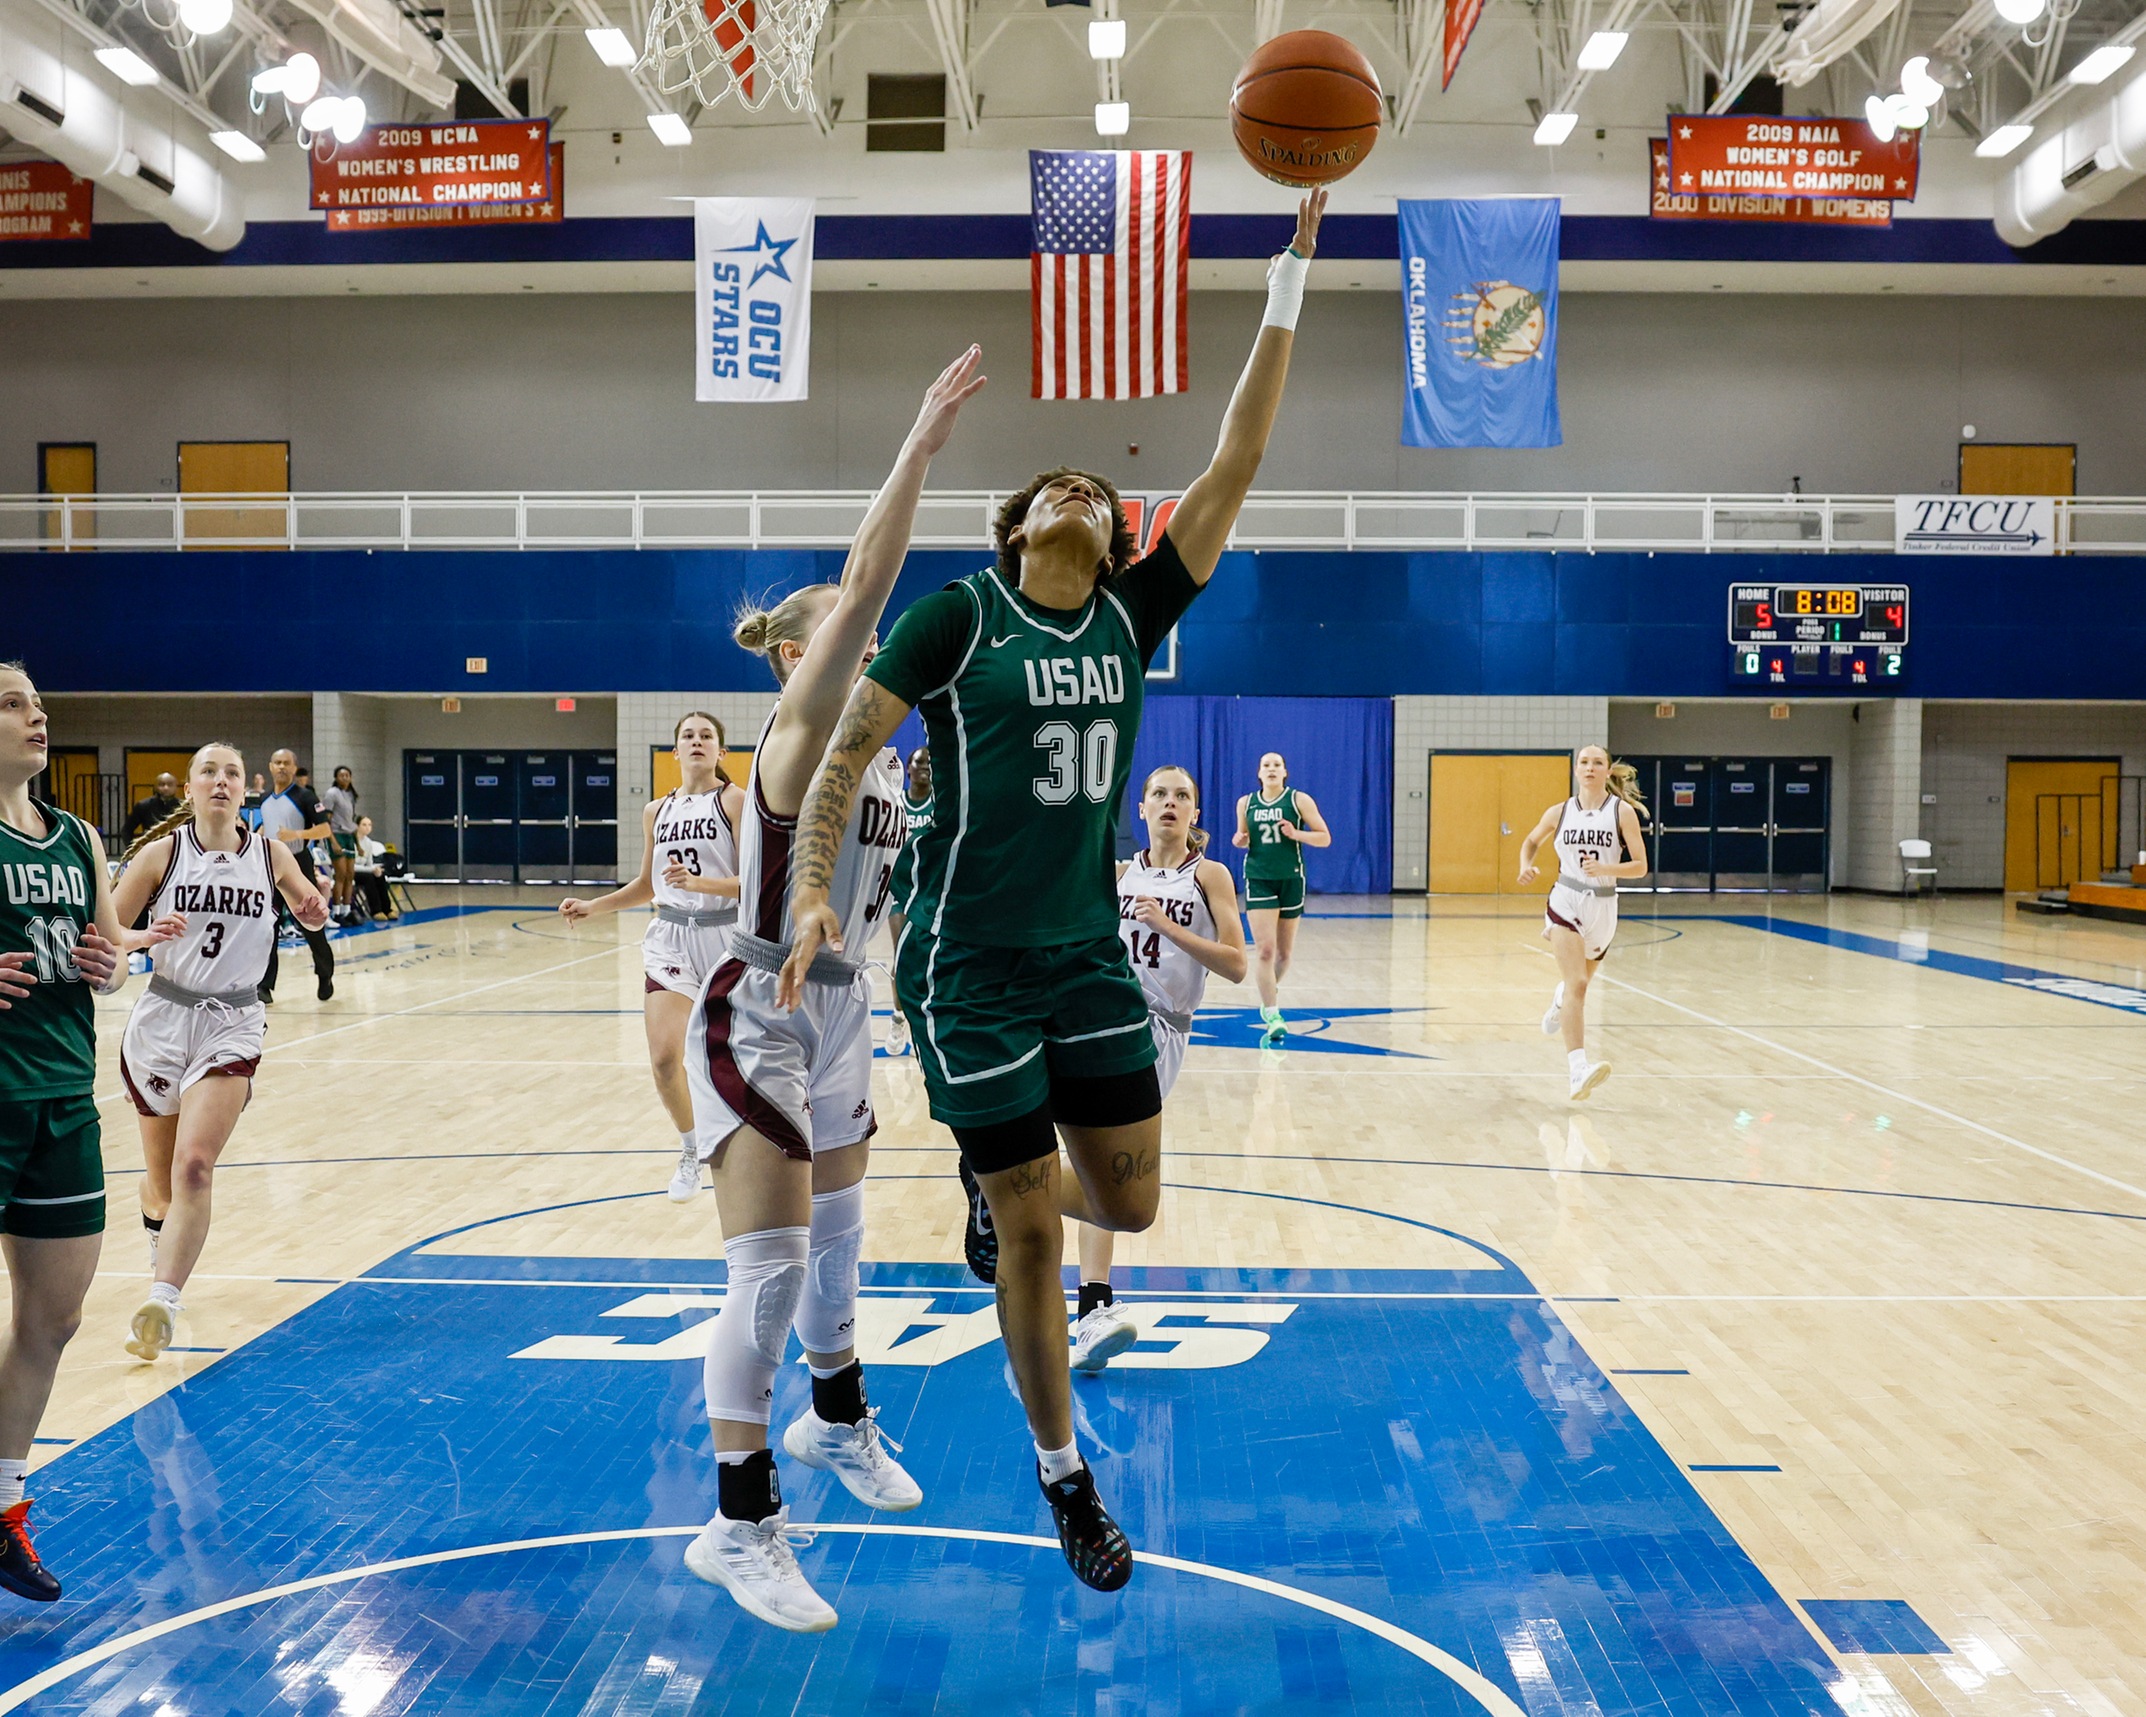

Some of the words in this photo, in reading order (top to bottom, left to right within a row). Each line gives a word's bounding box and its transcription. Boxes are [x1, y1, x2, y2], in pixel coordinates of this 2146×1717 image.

[378, 130, 422, 147] 2009
[430, 127, 479, 145] WCWA
[1747, 124, 1793, 142] 2009
[1798, 126, 1841, 143] NAIA
[1258, 136, 1359, 167] SPALDING
[1726, 147, 1809, 167] WOMEN'S
[1814, 150, 1862, 168] GOLF
[337, 158, 415, 176] WOMEN'S
[420, 153, 520, 174] WRESTLING
[0, 171, 29, 190] NIS
[1701, 170, 1788, 188] NATIONAL
[1793, 172, 1885, 191] CHAMPION
[338, 185, 423, 204] NATIONAL
[432, 181, 522, 201] CHAMPION
[1708, 197, 1786, 216] DIVISION
[0, 216, 51, 234] OGRAM
[713, 262, 740, 379] STARS
[1408, 256, 1428, 389] OKLAHOMA
[749, 300, 782, 383] OCU
[1913, 500, 2036, 533] TFCU
[1738, 588, 1770, 600] HOME
[1796, 590, 1856, 614] 8:08
[1863, 589, 1905, 602] VISITOR
[1756, 603, 1772, 628] 5
[1886, 605, 1903, 629] 4
[1750, 630, 1777, 640] BONUS
[1795, 625, 1825, 635] PERIOD
[1834, 622, 1841, 641] 1
[1859, 631, 1887, 641] BONUS
[1745, 653, 1760, 674] 0
[1770, 659, 1783, 673] 4
[1853, 660, 1866, 674] 4
[1887, 654, 1901, 675] 2
[1023, 654, 1125, 707] USAO
[1032, 718, 1119, 806] 30
[1254, 807, 1283, 822] USAO
[656, 818, 717, 845] ZARKS
[1258, 823, 1282, 844] 21
[1563, 829, 1613, 848] OZARKS
[3, 863, 86, 907] USAO
[175, 884, 265, 919] OZARKS
[25, 916, 82, 983] 10
[201, 922, 225, 959] 3
[1131, 930, 1160, 969] 14
